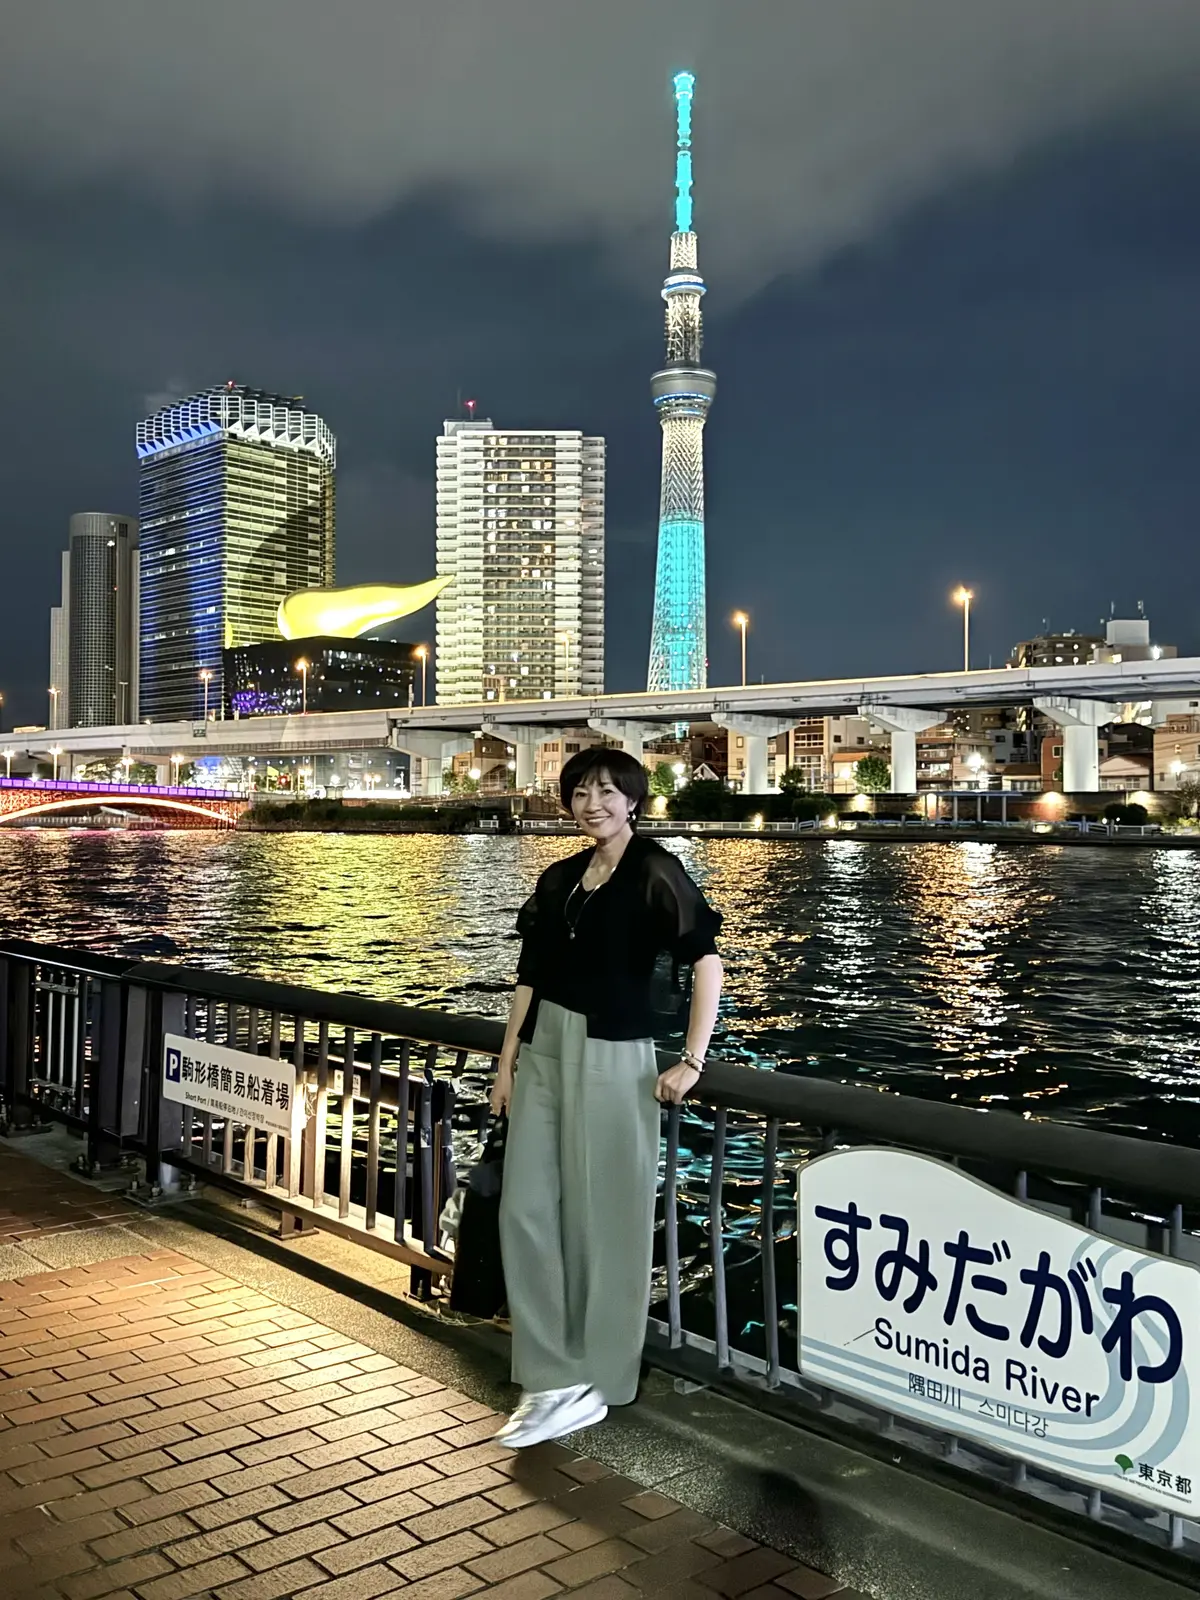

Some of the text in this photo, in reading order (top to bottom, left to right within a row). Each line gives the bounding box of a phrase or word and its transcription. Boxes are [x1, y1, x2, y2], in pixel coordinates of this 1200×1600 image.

[168, 1053, 290, 1111] P 駒形橋簡易船着場
[814, 1201, 1184, 1384] すみだがわ
[874, 1317, 1100, 1418] Sumida River
[908, 1372, 1049, 1438] 隅田川 스미다강
[1138, 1462, 1192, 1495] 東京都
